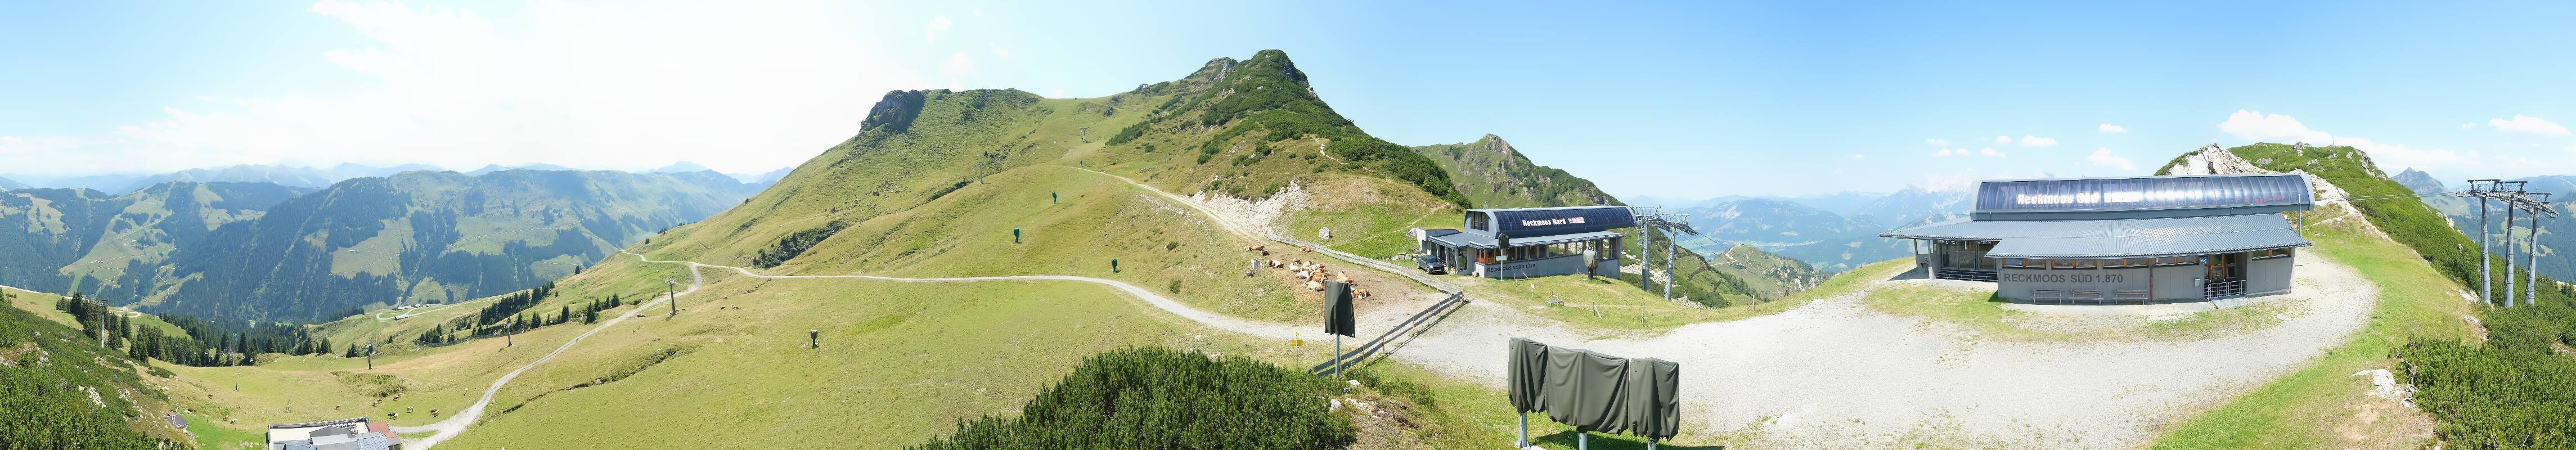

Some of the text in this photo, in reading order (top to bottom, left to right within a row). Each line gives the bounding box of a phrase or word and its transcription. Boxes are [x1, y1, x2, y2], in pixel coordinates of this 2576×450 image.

[2017, 194, 2074, 204] Reckmoos
[2004, 273, 2123, 283] RECKMOOS SÜD 1.870
